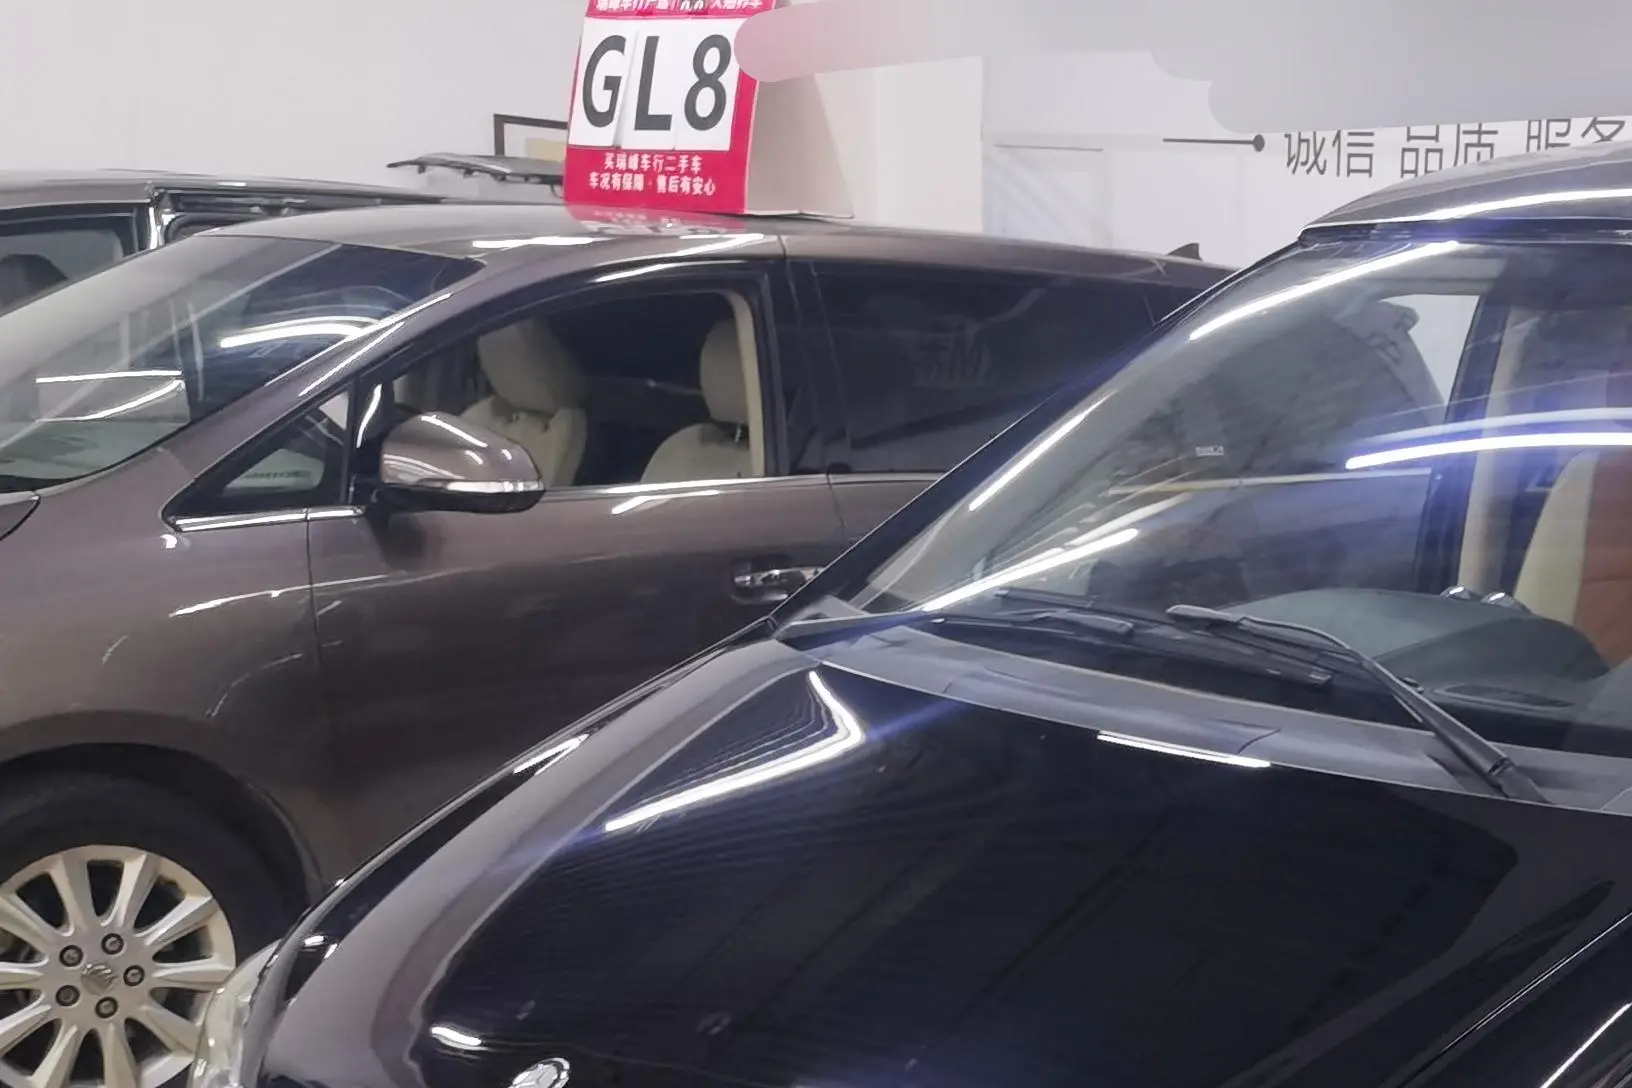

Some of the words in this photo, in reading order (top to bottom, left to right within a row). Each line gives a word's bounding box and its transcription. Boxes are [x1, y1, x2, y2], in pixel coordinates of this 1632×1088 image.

[582, 34, 732, 132] GL8
[604, 152, 703, 174] 买瑞峰车行二手车
[1284, 129, 1375, 178] 诚信
